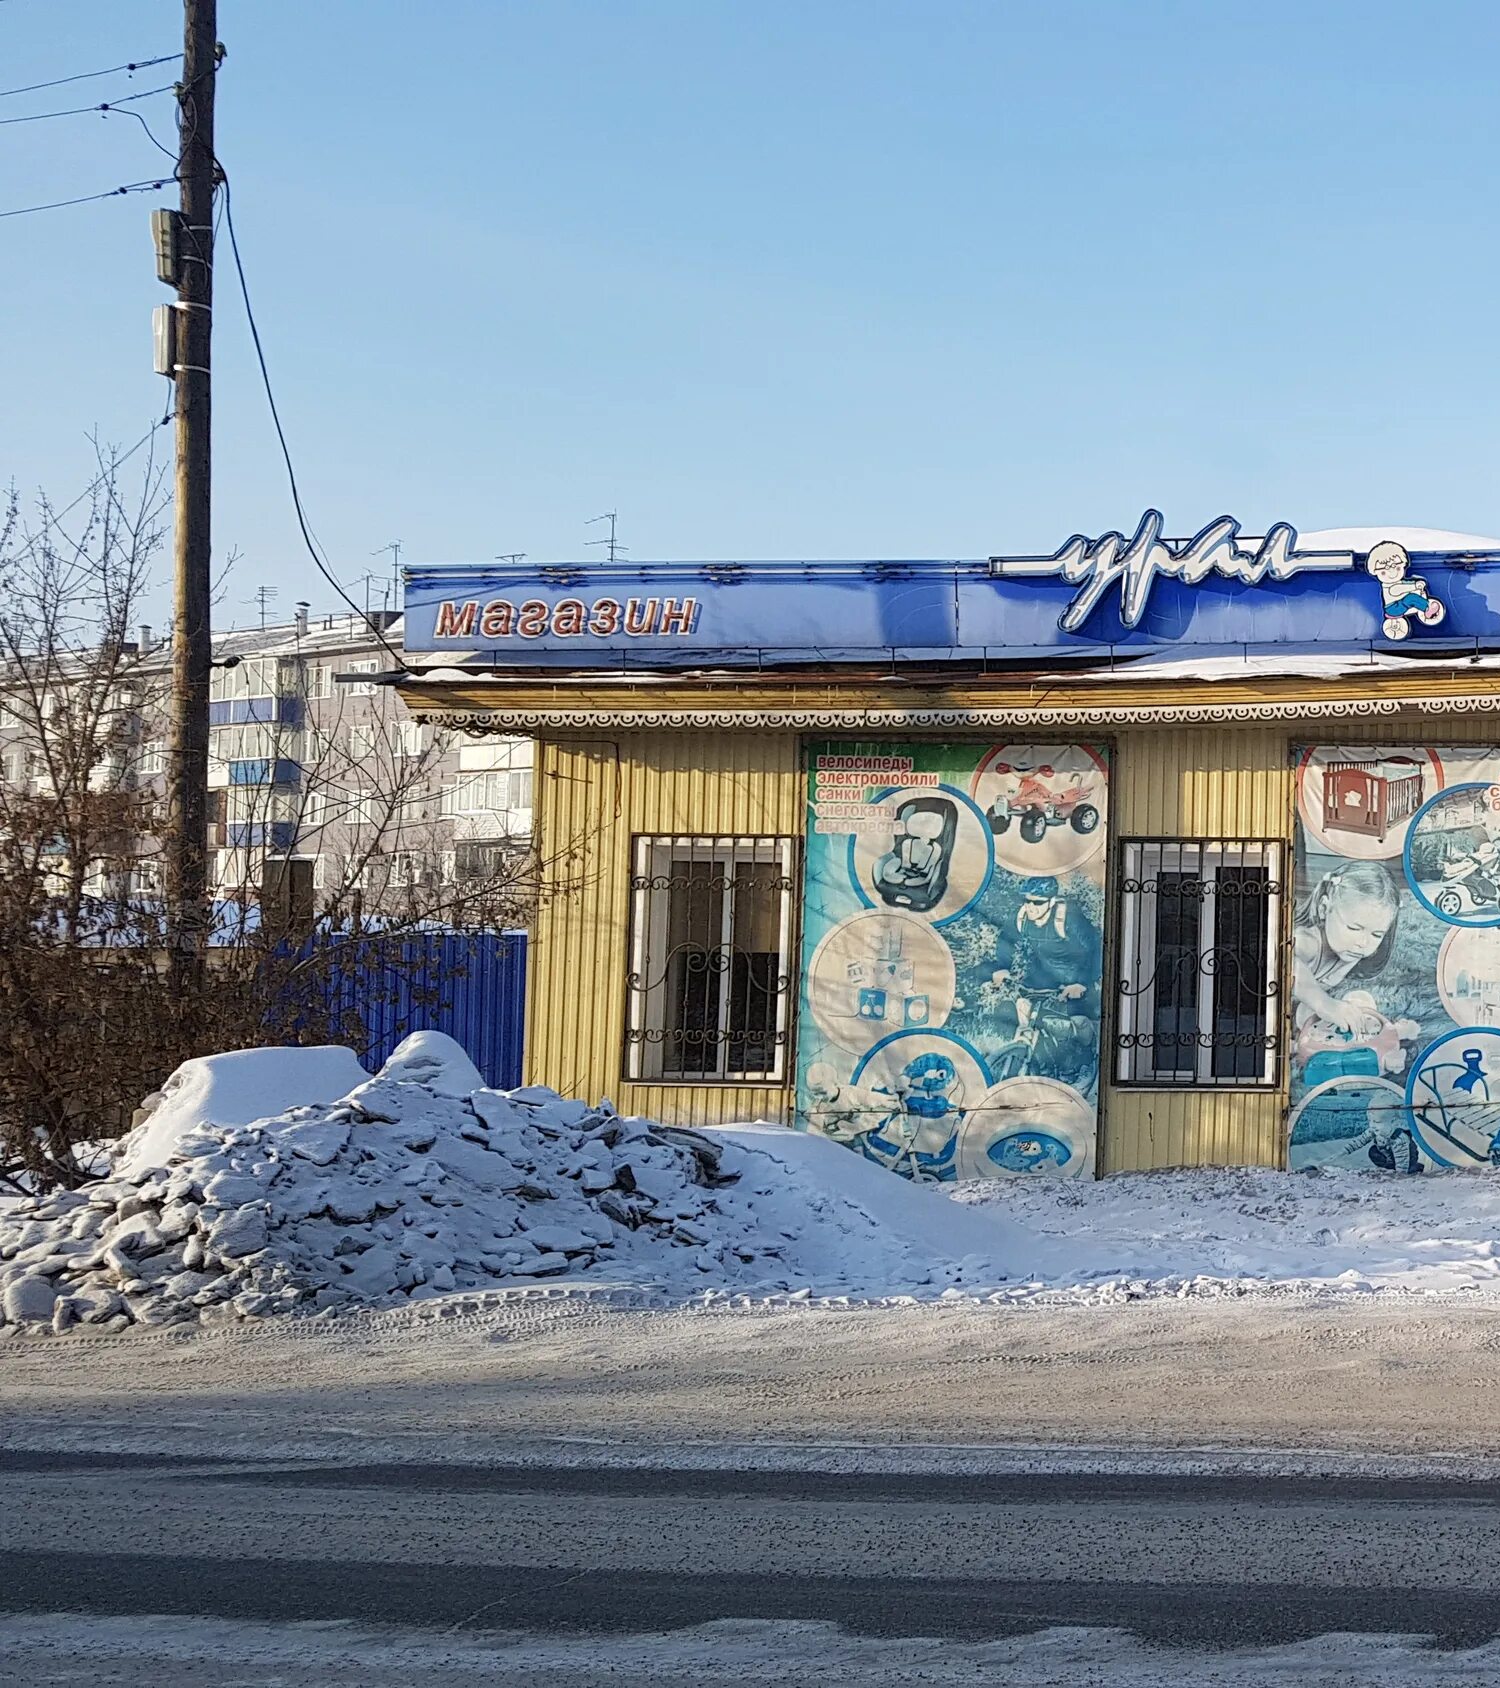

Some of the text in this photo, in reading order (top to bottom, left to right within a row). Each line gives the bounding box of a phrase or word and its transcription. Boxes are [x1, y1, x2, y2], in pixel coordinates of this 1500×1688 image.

[433, 597, 697, 639] магазин
[817, 756, 913, 770] велосипеды
[816, 770, 938, 787] электромобили
[816, 788, 861, 801] санки
[816, 804, 896, 818] снегокаты
[815, 821, 904, 835] автокресла
